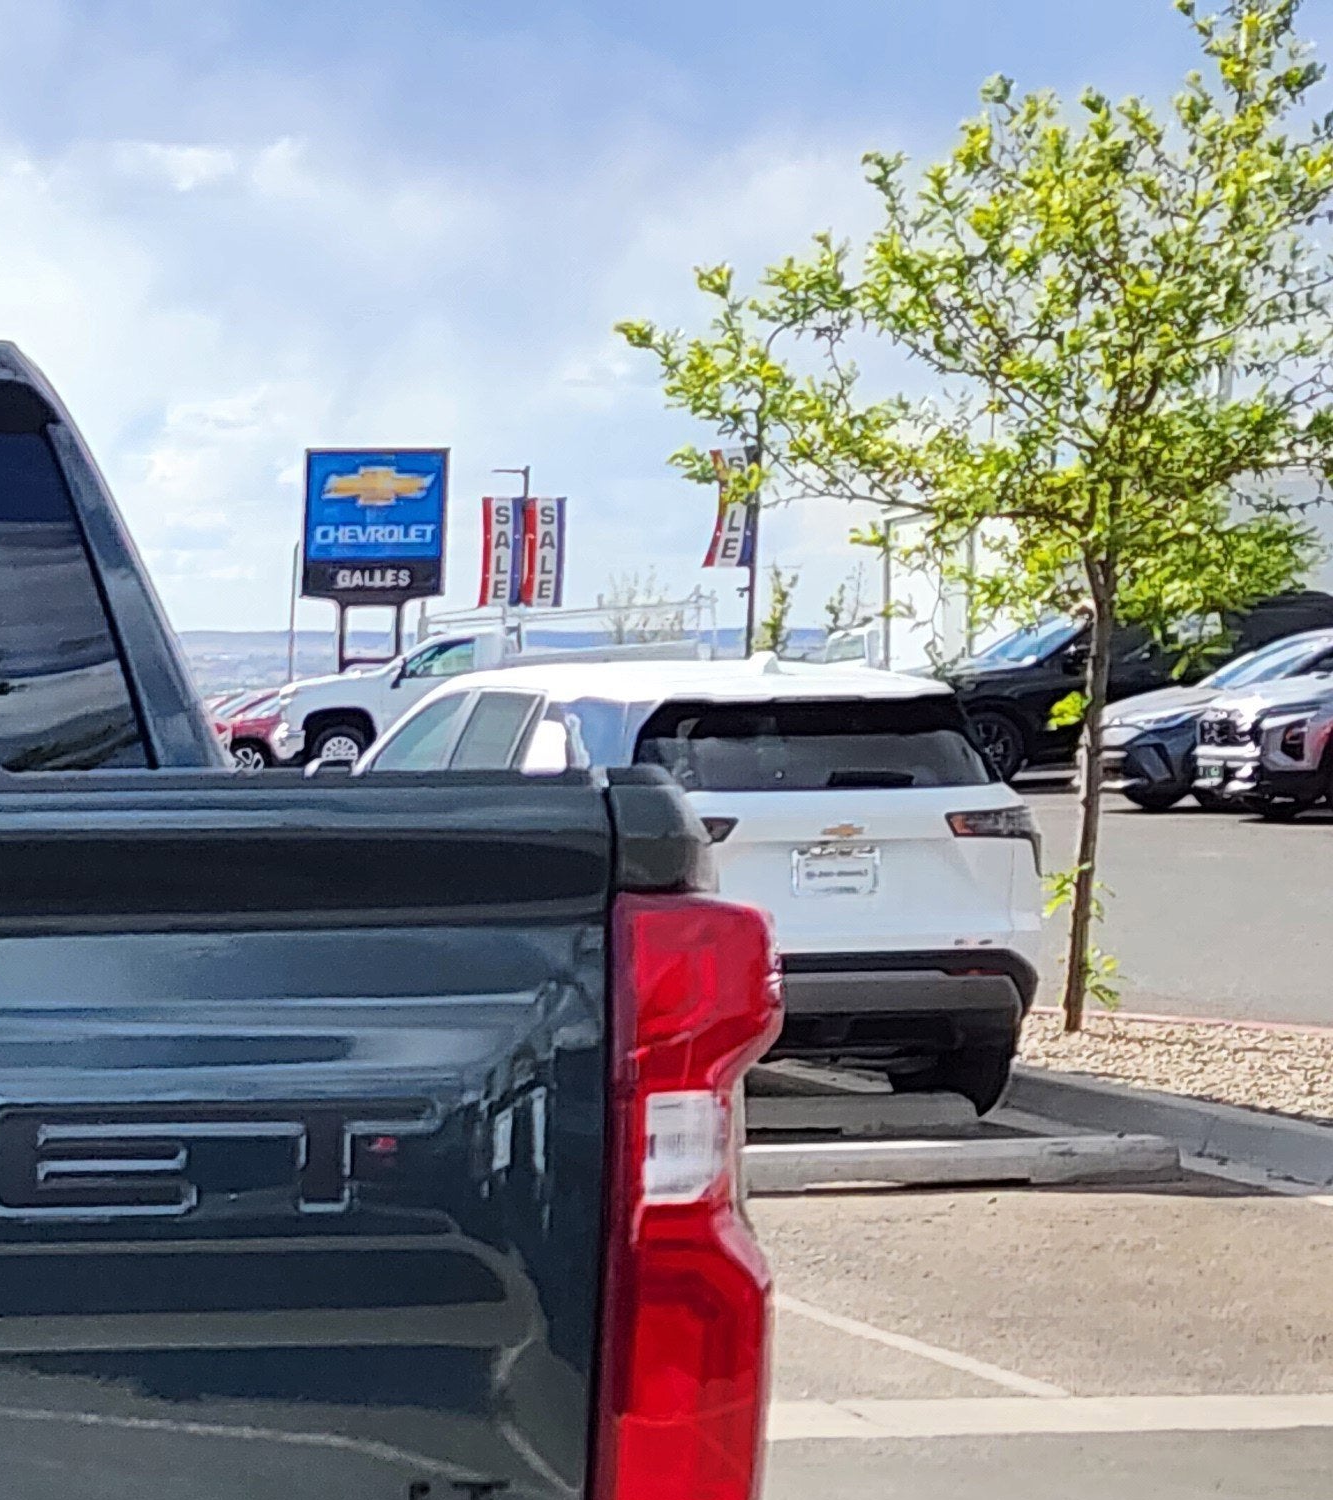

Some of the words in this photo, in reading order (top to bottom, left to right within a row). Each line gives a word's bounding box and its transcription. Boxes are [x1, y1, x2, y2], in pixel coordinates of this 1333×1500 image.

[315, 523, 436, 544] CHEVROLET
[492, 505, 511, 599] SALE
[537, 505, 556, 599] SALE
[721, 456, 746, 559] SLE
[334, 569, 411, 589] GALLES
